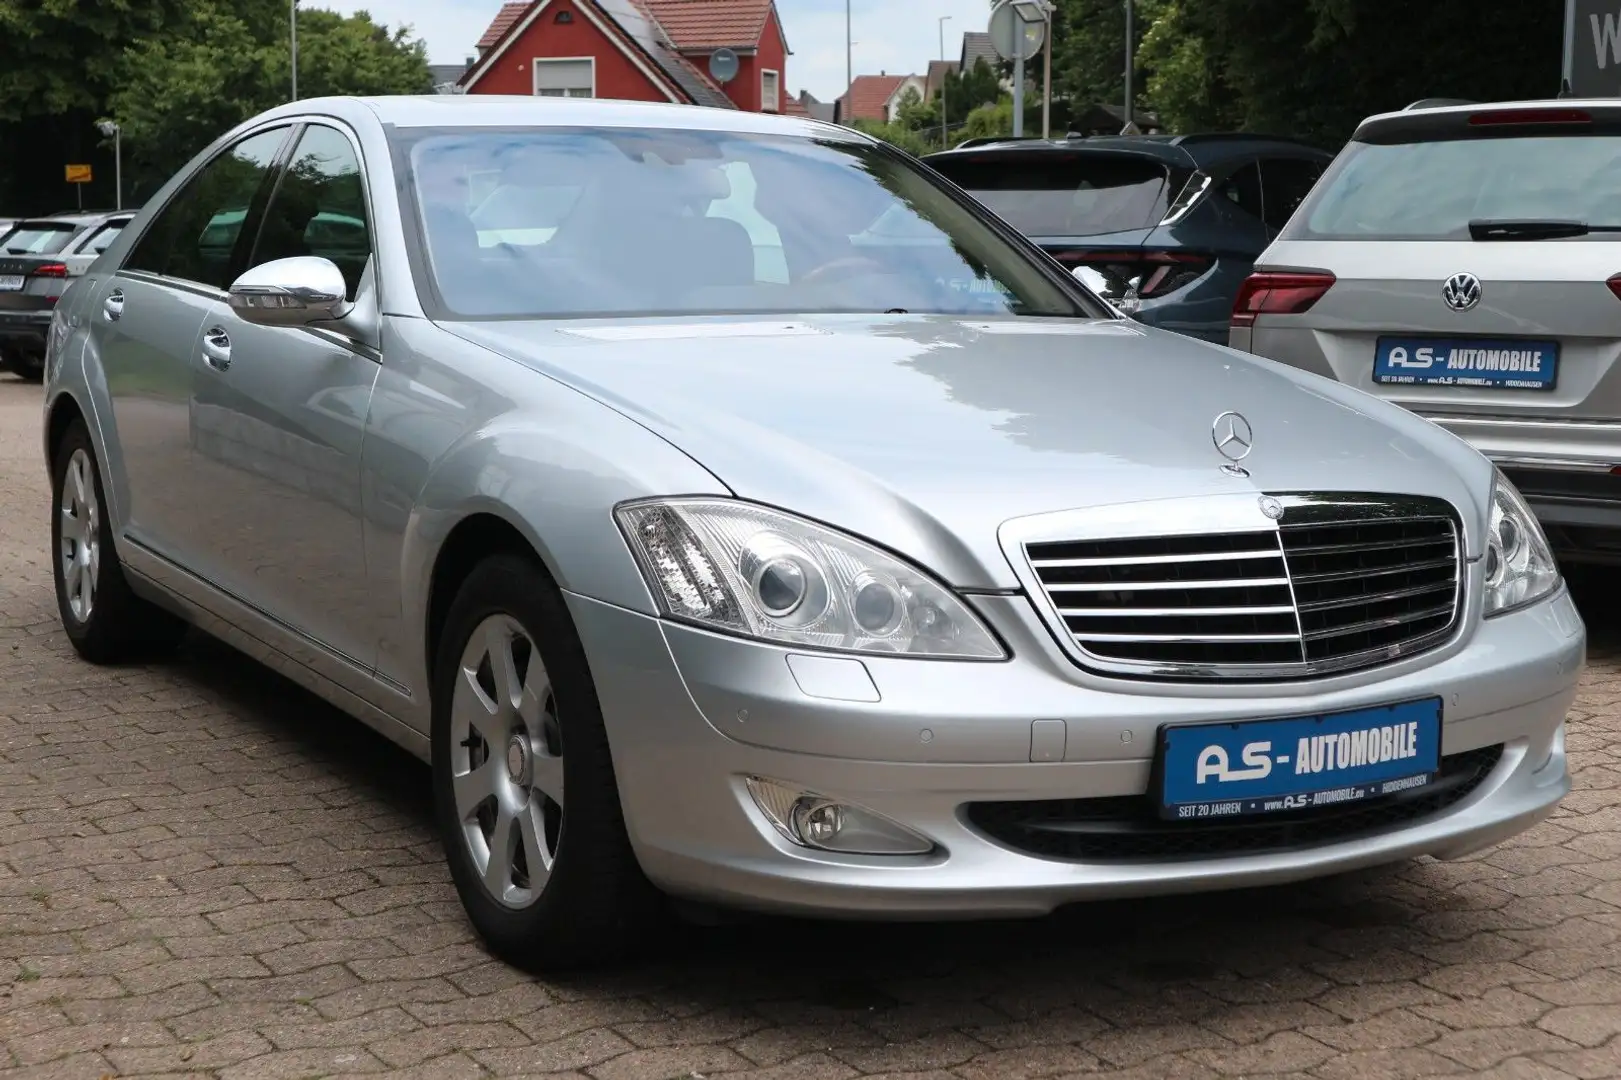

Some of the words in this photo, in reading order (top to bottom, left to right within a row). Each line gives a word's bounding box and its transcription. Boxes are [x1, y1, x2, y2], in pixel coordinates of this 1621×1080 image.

[1178, 805, 1197, 818] SEIT
[1197, 804, 1209, 817] 20
[1210, 802, 1242, 816] JAHREN
[1382, 774, 1428, 794] HIDDENHAUSEN
